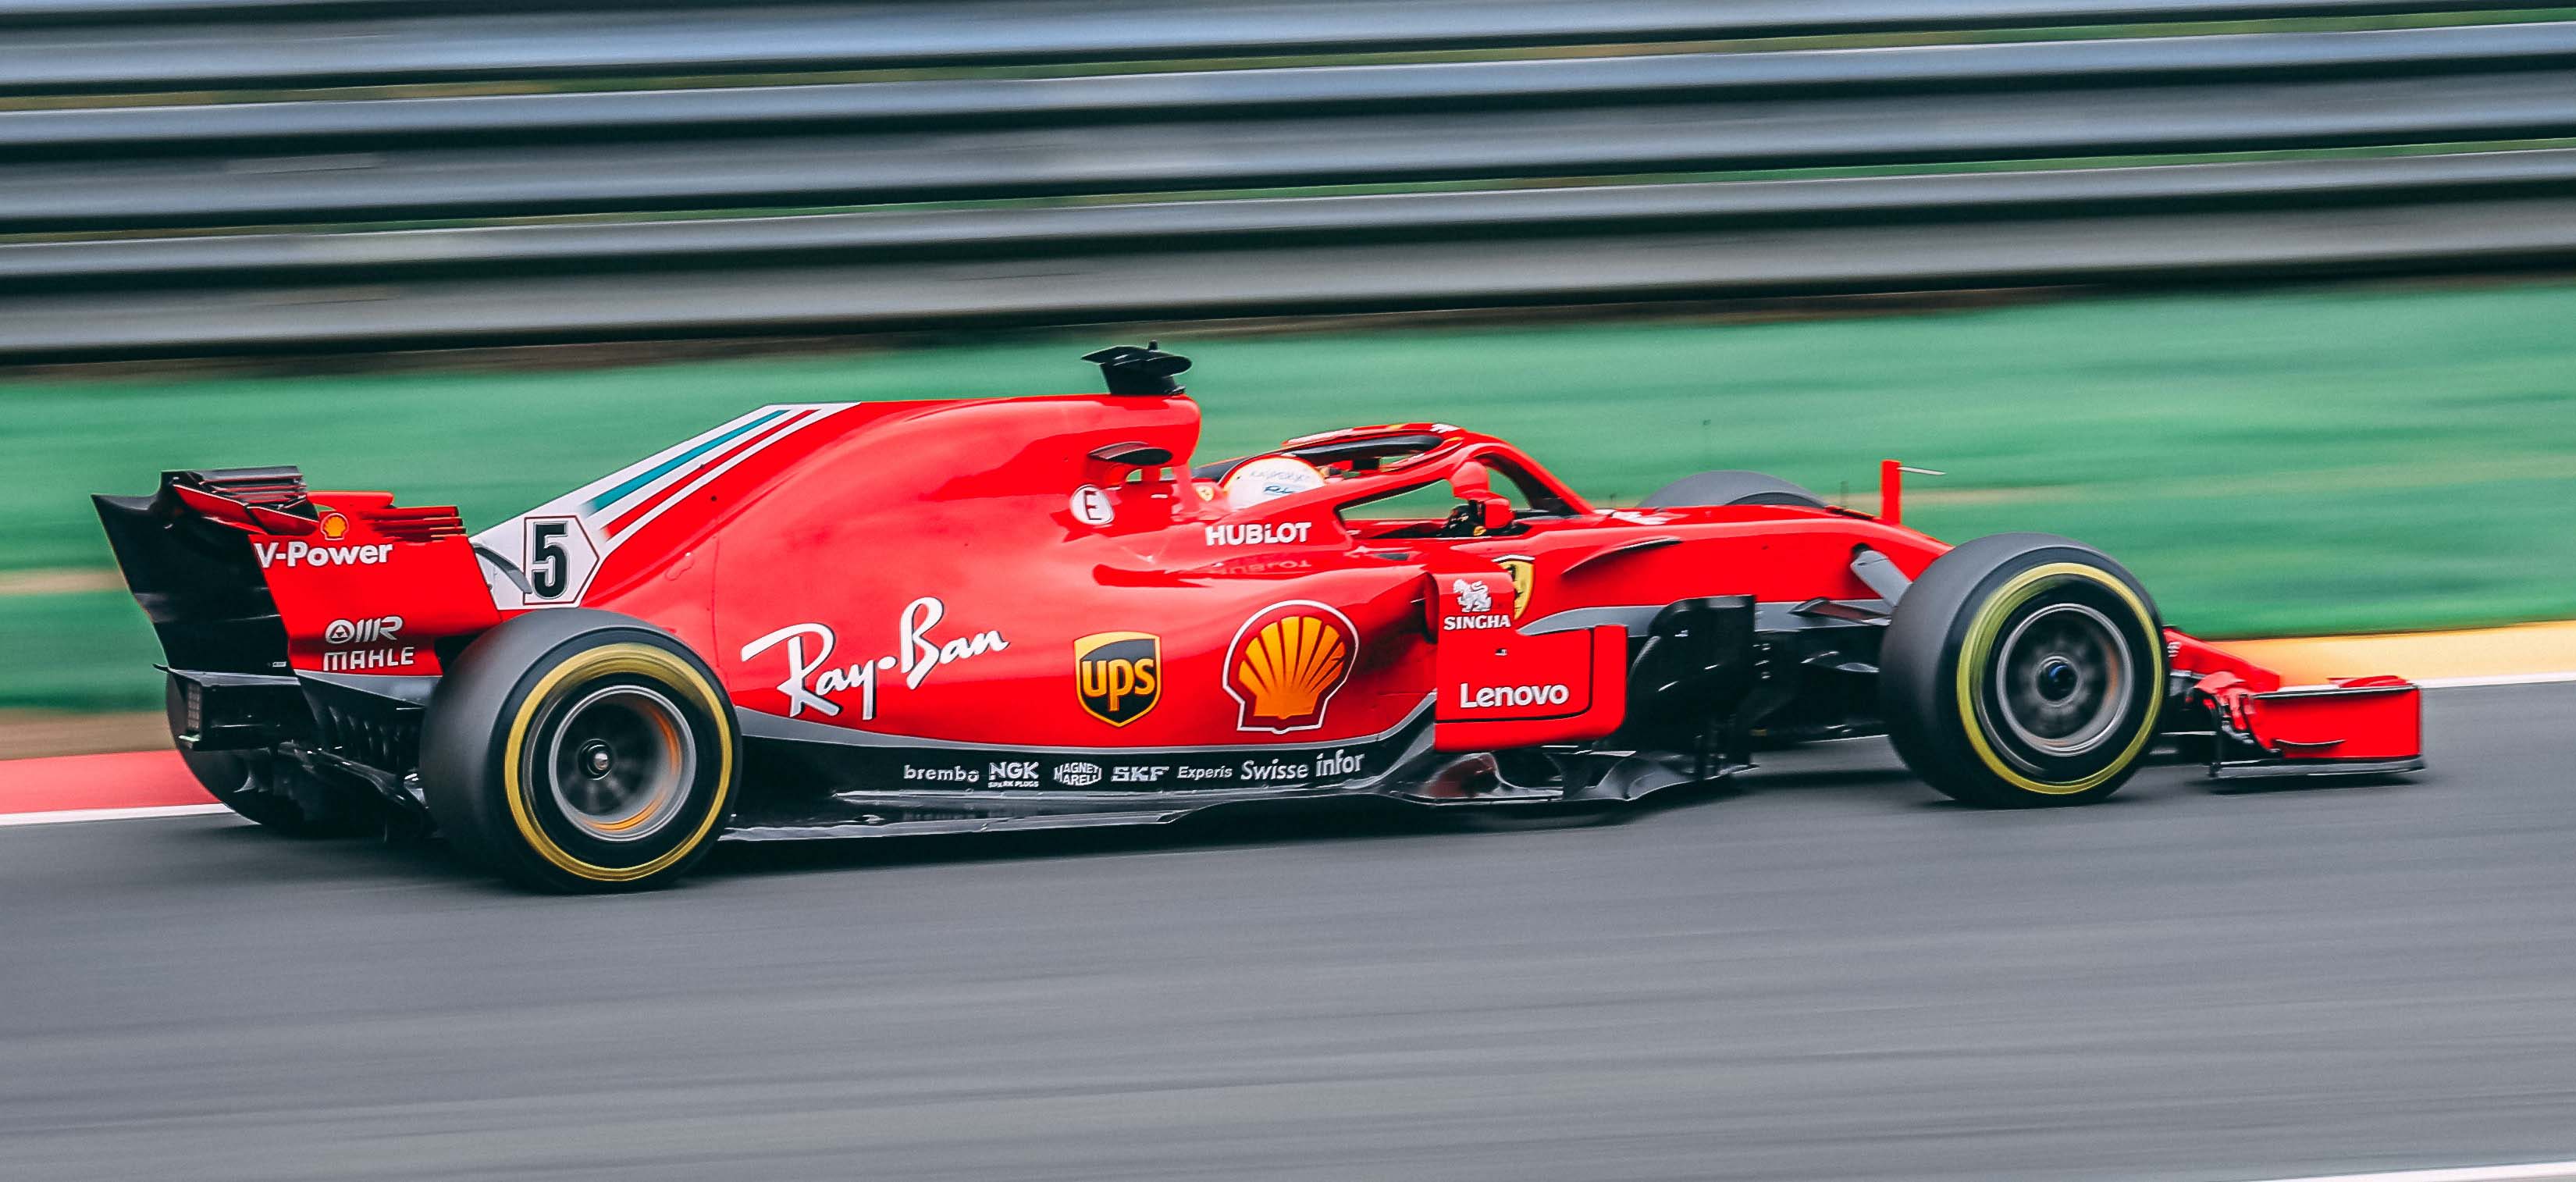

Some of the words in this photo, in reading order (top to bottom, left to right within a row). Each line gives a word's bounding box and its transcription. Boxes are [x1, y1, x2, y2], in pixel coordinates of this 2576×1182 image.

[1083, 490, 1102, 521] E
[1204, 522, 1312, 546] HUBLOT
[253, 540, 393, 568] V-Power
[532, 520, 570, 600] 5
[1443, 614, 1512, 631] SINGHA
[322, 646, 415, 672] MAHLE
[1080, 657, 1156, 712] ups
[1460, 682, 1571, 709] Lenovo
[903, 764, 980, 782] brembo
[988, 761, 1040, 781] NGK
[1109, 766, 1170, 782] SKF
[1176, 765, 1233, 781] Experis
[1240, 758, 1309, 781] Swisse
[1315, 749, 1365, 777] infor
